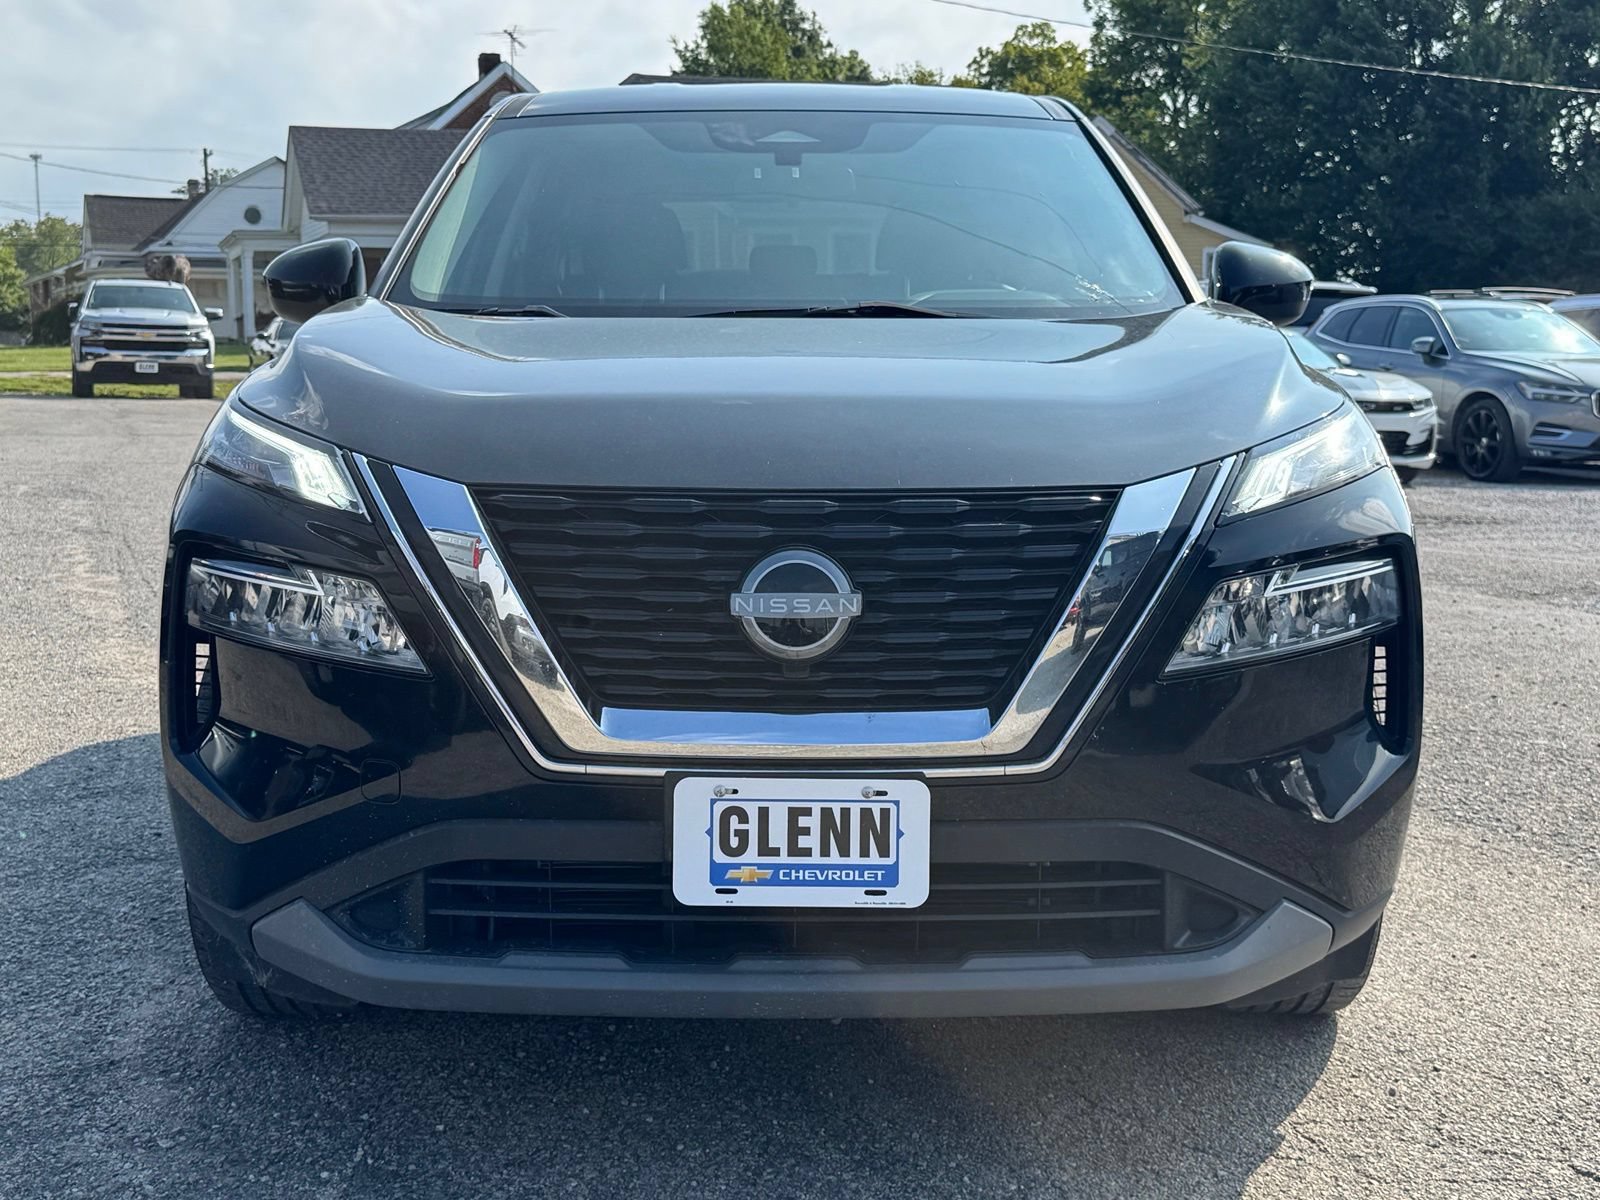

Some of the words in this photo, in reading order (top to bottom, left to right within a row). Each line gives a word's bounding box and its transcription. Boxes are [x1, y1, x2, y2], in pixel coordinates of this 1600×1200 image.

[735, 597, 857, 613] NISSAN
[718, 805, 891, 859] GLENN
[779, 869, 886, 881] CHEVROLET
